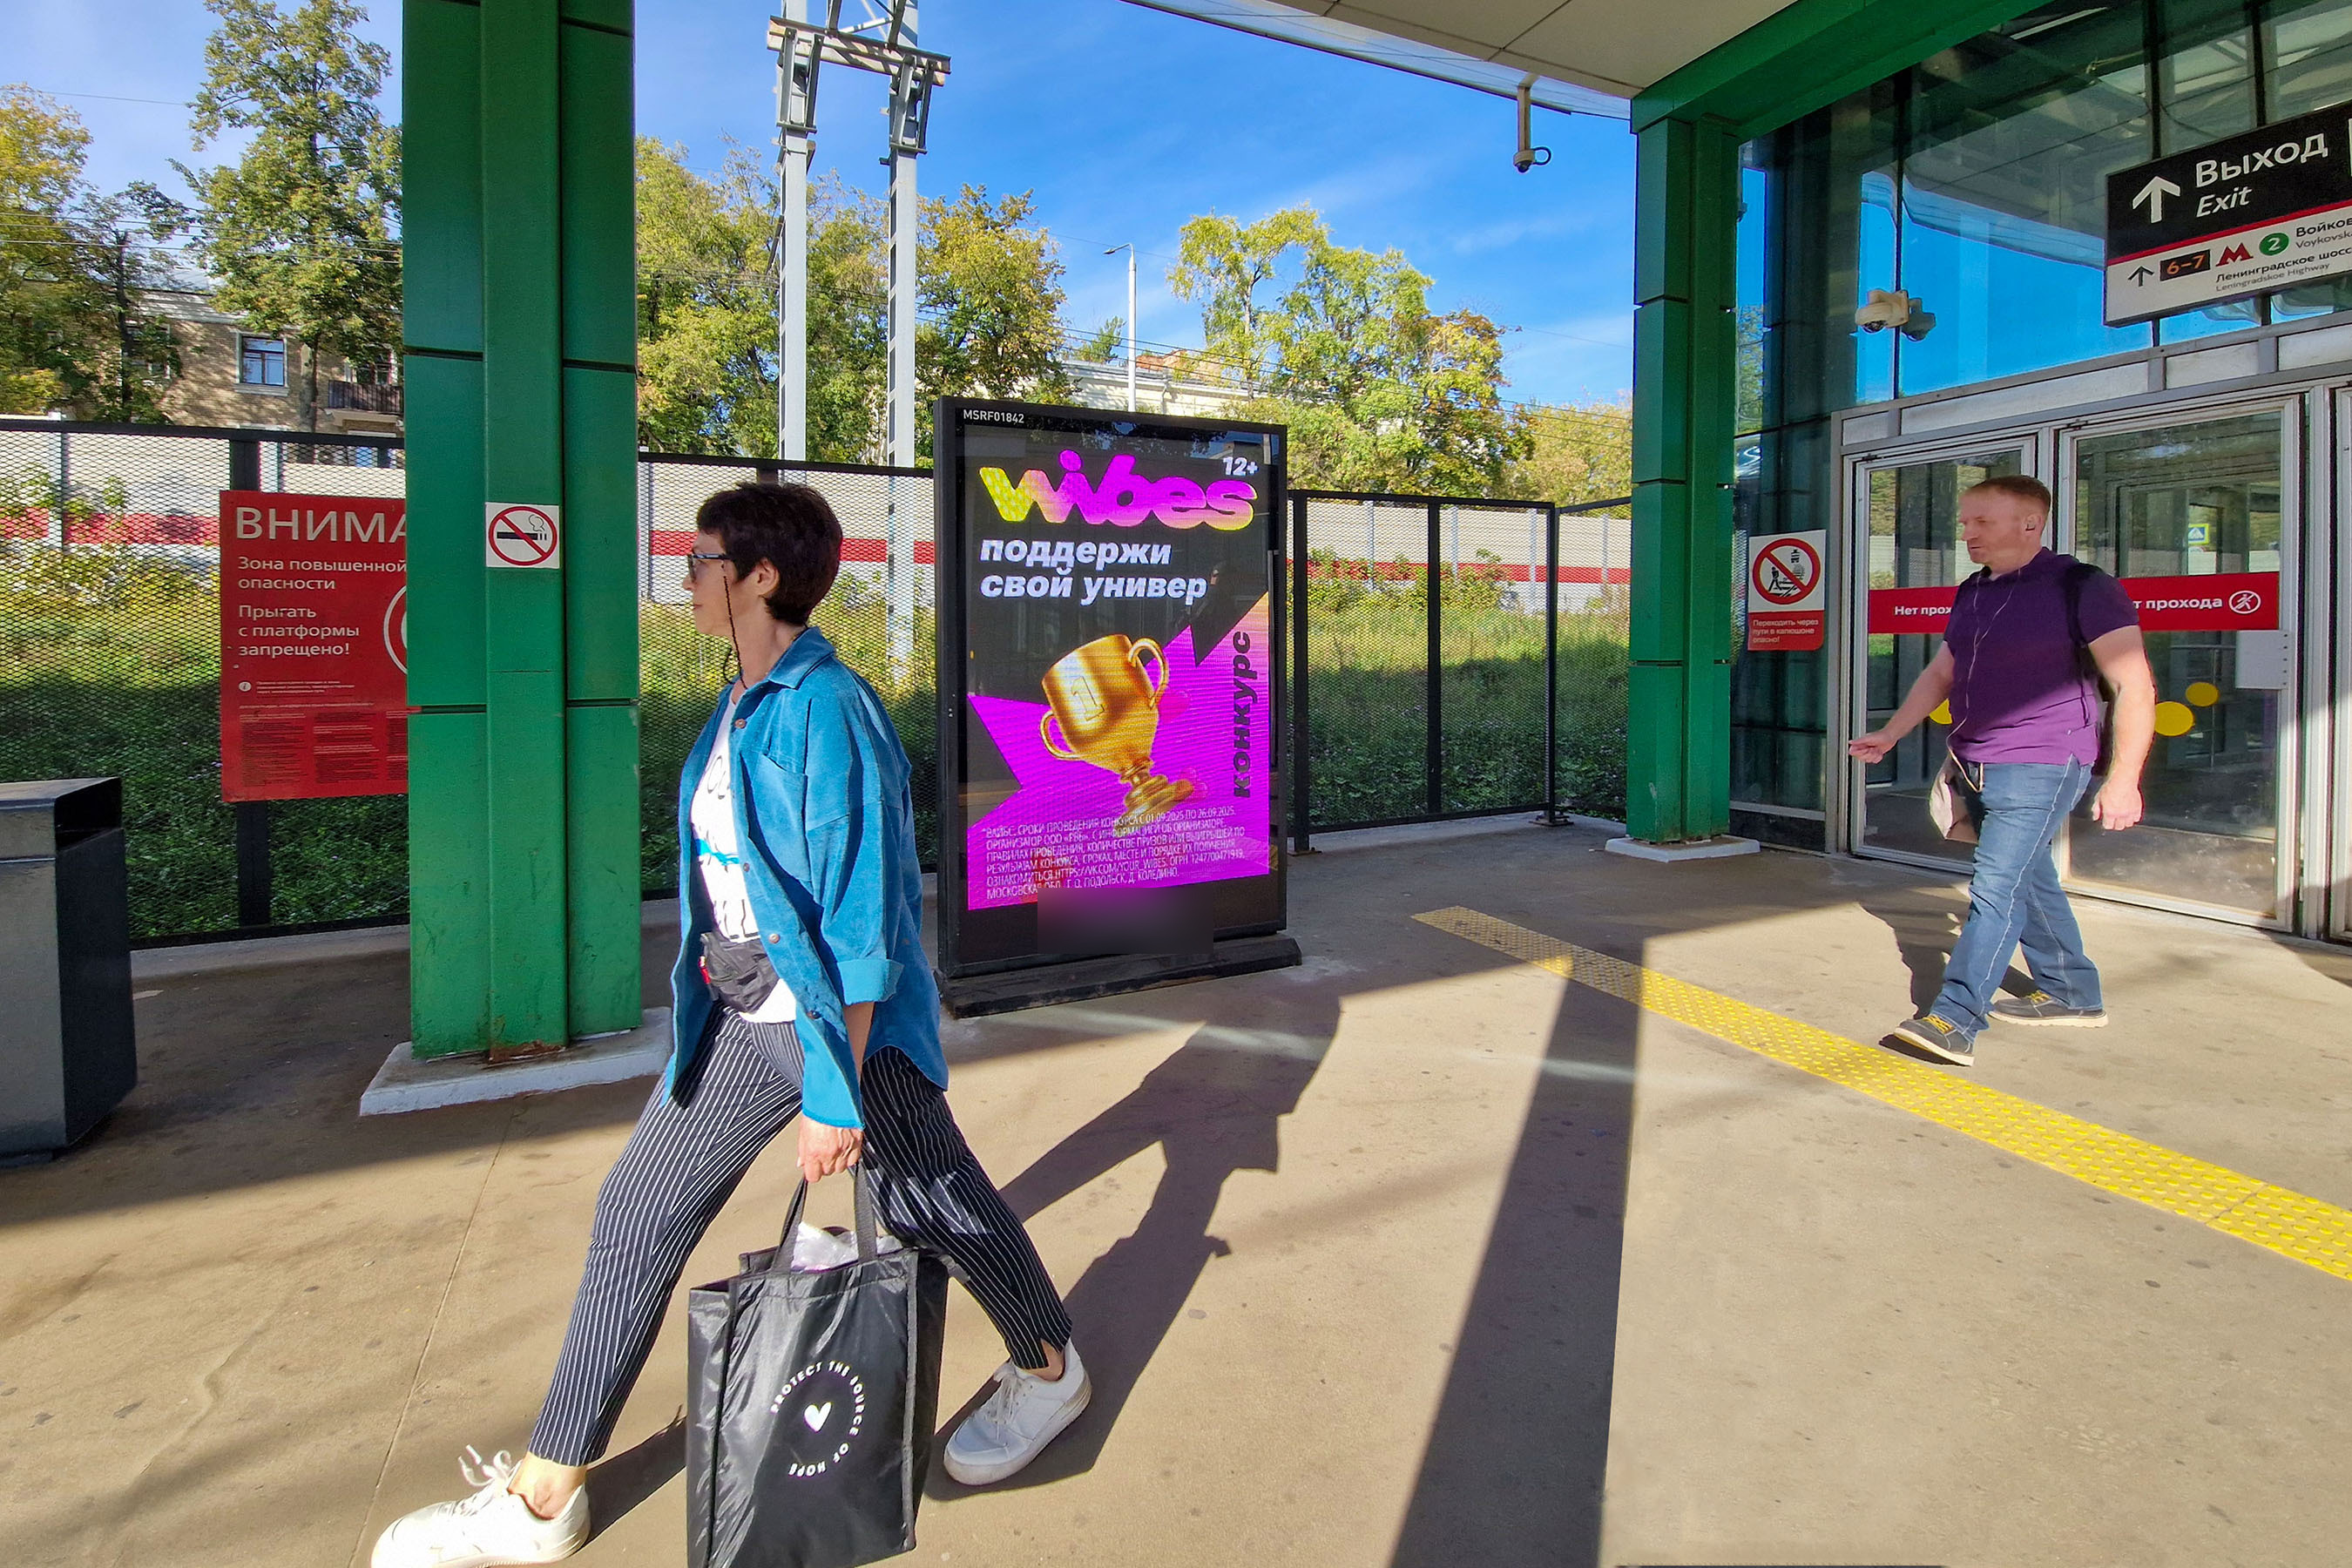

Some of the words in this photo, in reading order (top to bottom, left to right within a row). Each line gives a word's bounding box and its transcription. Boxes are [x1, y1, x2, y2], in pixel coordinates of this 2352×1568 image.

[2195, 133, 2328, 188] Выход
[2196, 186, 2253, 218] Exit
[2295, 230, 2352, 248] Voykovsk
[2216, 255, 2315, 283] Ленинградское
[2216, 271, 2285, 292] Leningradskoe
[2287, 263, 2330, 276] Highway
[963, 409, 1024, 424] MSRF01842
[1222, 456, 1259, 476] 12+
[238, 556, 284, 571] Зона
[289, 559, 407, 573] повышенной
[980, 539, 1172, 571] поддержи
[238, 578, 336, 590] опасности
[980, 567, 1073, 598] свой
[1080, 576, 1208, 606] универ
[239, 605, 317, 620] Прыгать
[1894, 605, 1919, 616] Нет
[1920, 606, 1952, 617] прох
[2146, 598, 2223, 612] прохода
[238, 628, 249, 638] с
[252, 625, 360, 639] платформы
[238, 643, 350, 659] запрещено!
[1071, 676, 1105, 721] 1
[1233, 630, 1259, 798] конкурс
[1017, 822, 1044, 835] СРОКИ
[1046, 817, 1099, 832] ПРОВЕДЕНИЯ
[1185, 808, 1197, 820] ПО
[986, 835, 1042, 850] ОРГАНИЗАТОР
[1043, 833, 1063, 845] ООО
[986, 848, 1029, 862] ПРАВИЛАХ
[1087, 837, 1135, 852] КОЛИЧЕСТВЕ
[1137, 834, 1166, 847] ПРИЗОВ
[1233, 827, 1245, 837] ПО
[1149, 844, 1181, 857] ПОРЯДКЕ
[1193, 838, 1234, 853] ПОЛУЧЕНИЯ
[1169, 855, 1189, 867] ОГРН
[828, 1361, 850, 1377] THE
[770, 1362, 822, 1414] PROTECT
[849, 1375, 865, 1436] SOURCE
[833, 1443, 849, 1463] OF
[788, 1461, 826, 1477] HOPE
